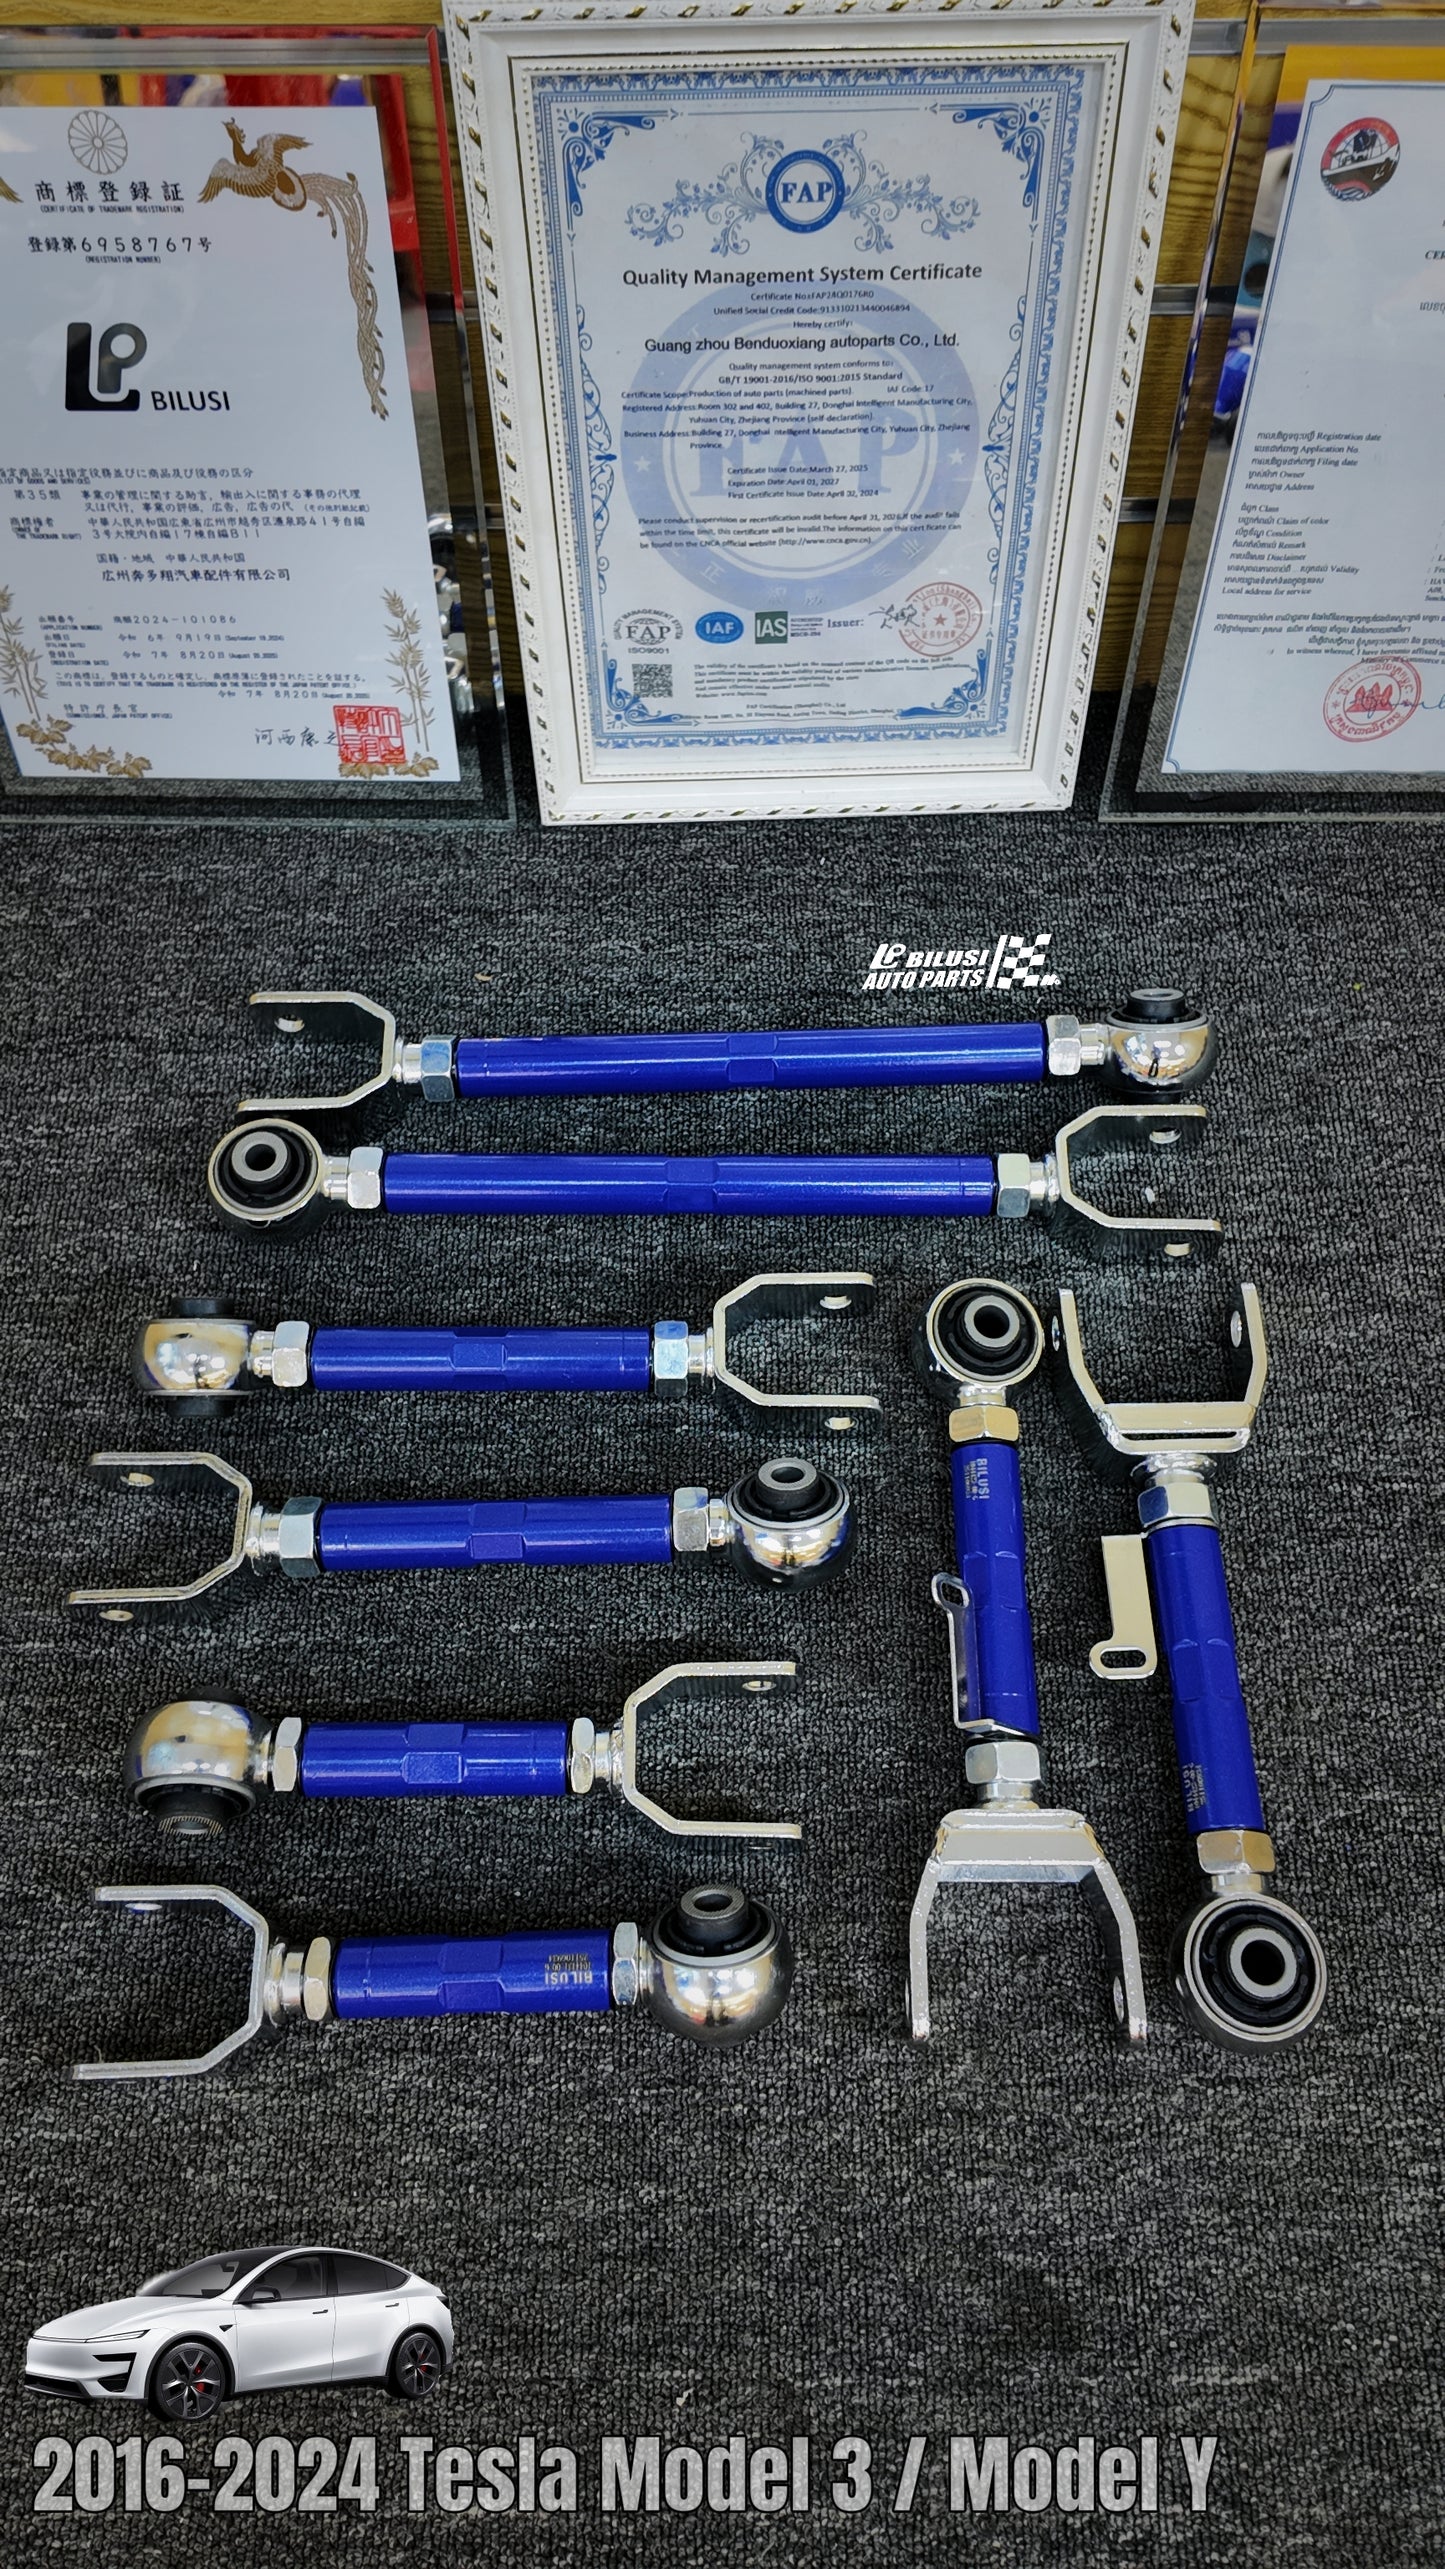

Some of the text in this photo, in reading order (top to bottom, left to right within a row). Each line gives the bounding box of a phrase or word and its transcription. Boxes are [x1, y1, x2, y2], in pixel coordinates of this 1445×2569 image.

[34, 180, 184, 203] 商標登録証
[780, 181, 834, 203] FAP
[28, 236, 211, 254] 登録第6958767号
[623, 263, 982, 287] Quality Management System Certificate
[751, 293, 792, 301] Certificate
[714, 307, 742, 315] Unified
[793, 321, 822, 329] Hereby
[645, 332, 960, 354] Guang zhou Benduoxiang autoparts Co., Ltd.
[729, 360, 879, 371] Quality management system conforms
[719, 372, 903, 385] GB/T 19001-2016/ISO 9001:2015 Standard
[621, 391, 661, 399] Certificate
[764, 389, 783, 398] parts
[786, 388, 826, 398] (machined
[151, 390, 230, 412] BILUSI
[623, 404, 662, 413] Registered
[723, 403, 736, 411] 302
[756, 403, 773, 411] 402,
[775, 401, 806, 411] Building
[808, 401, 820, 410] 27,
[822, 400, 854, 409] Donghai
[856, 399, 895, 408] Intelligent
[897, 398, 954, 406] Manufacturing
[719, 416, 736, 424] City,
[738, 415, 770, 424] Zhejiang
[772, 414, 806, 423] Province
[624, 430, 657, 438] Business
[724, 429, 736, 438] 27,
[739, 429, 770, 438] Donghai
[812, 426, 869, 435] Manufacturing
[871, 425, 888, 434] City,
[889, 425, 918, 433] Yuhuan
[938, 423, 971, 432] Zhejiang
[1316, 432, 1363, 441] Registration
[1300, 445, 1344, 455] Application
[1317, 458, 1339, 466] Filing
[727, 466, 766, 475] Certificate
[835, 465, 847, 473] 27,
[849, 464, 868, 472] 2025
[1280, 470, 1304, 478] Owner
[728, 478, 839, 488] Expiration 01, 2027
[1284, 483, 1314, 491] Address
[746, 491, 784, 499] Certificate
[860, 489, 879, 497] 2024
[638, 517, 662, 525] Please
[664, 516, 694, 525] conduct
[695, 516, 738, 525] supervision
[749, 514, 801, 523] recertification
[823, 513, 847, 521] before
[850, 513, 867, 522] April
[910, 512, 922, 520] the
[945, 511, 960, 519] fails
[1277, 517, 1298, 525] Claim
[1310, 517, 1329, 525] color
[640, 529, 662, 537] within
[664, 528, 676, 536] the
[678, 527, 695, 536] time
[718, 527, 731, 535] this
[733, 527, 769, 535] certificate
[772, 526, 784, 534] will
[838, 524, 881, 533] information
[895, 524, 908, 532] this
[1266, 529, 1302, 537] Condition
[651, 540, 672, 548] found
[700, 539, 720, 547] CNCA
[722, 539, 746, 547] official
[749, 538, 776, 546] website
[1278, 541, 1306, 549] Remark
[1330, 566, 1360, 575] Validity
[705, 622, 734, 634] IAF
[757, 618, 787, 637] IAS
[828, 618, 864, 628] Issuer:
[625, 625, 671, 639] FAP
[976, 1458, 990, 1499] BILUSI
[544, 1971, 593, 1985] BILUSI
